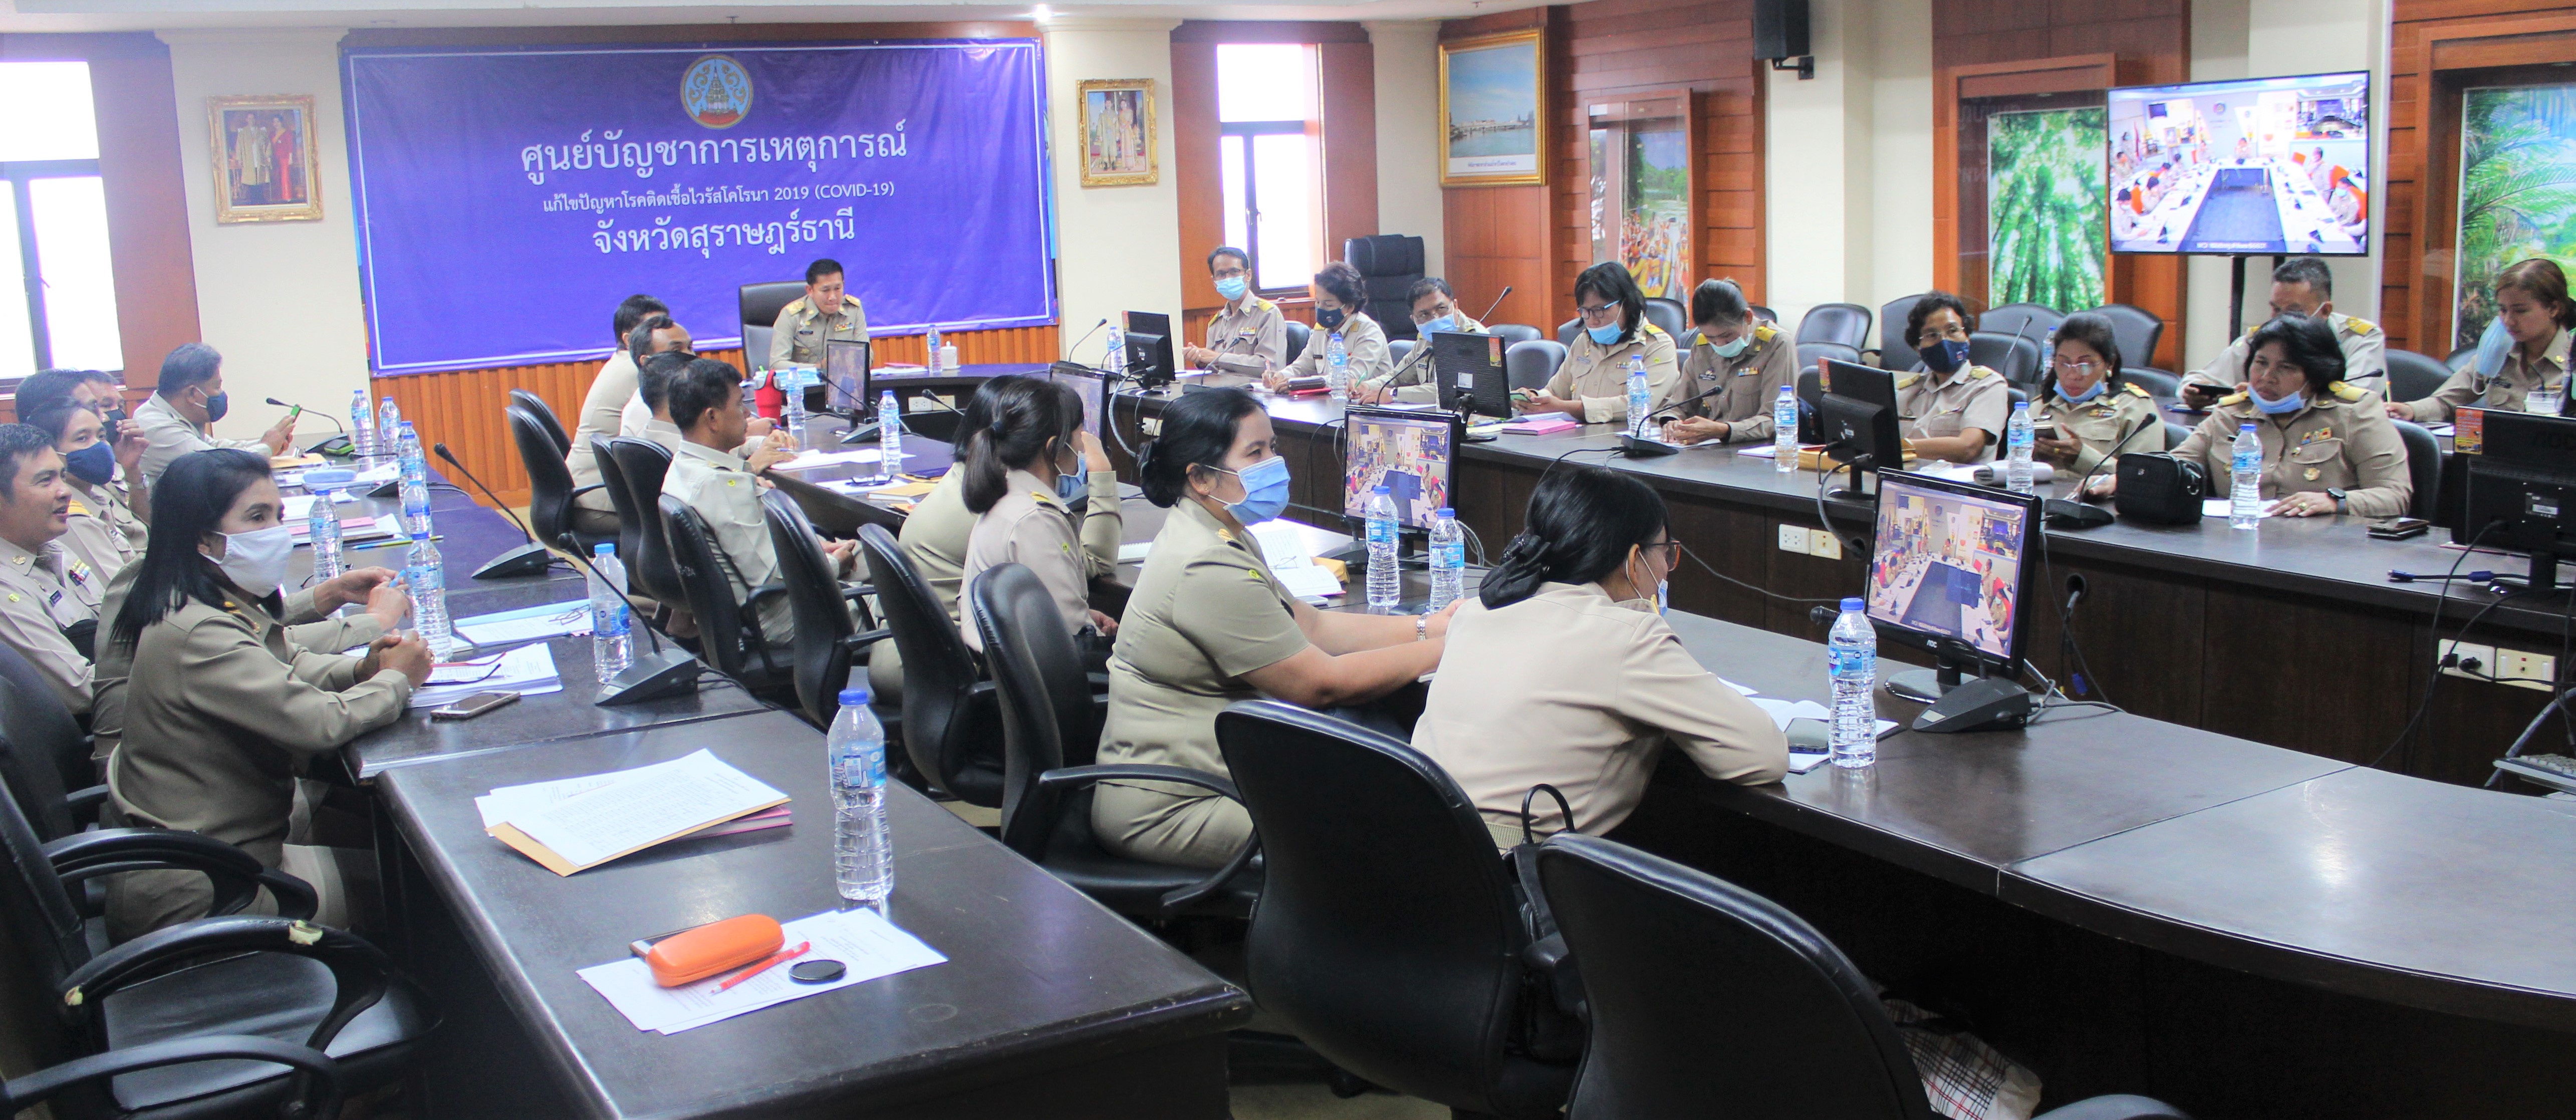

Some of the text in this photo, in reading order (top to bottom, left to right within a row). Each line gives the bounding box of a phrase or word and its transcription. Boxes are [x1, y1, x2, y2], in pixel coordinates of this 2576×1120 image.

[521, 118, 907, 185] ศูนย์บัญชาการเหตุการณ์
[543, 181, 895, 214] แก้ไขปัญหาโรคติดเชื้อไวรัสโคโรนา 2019 (COVID-19)
[592, 207, 855, 260] จังหวัดสุราษฎร์ธานี
